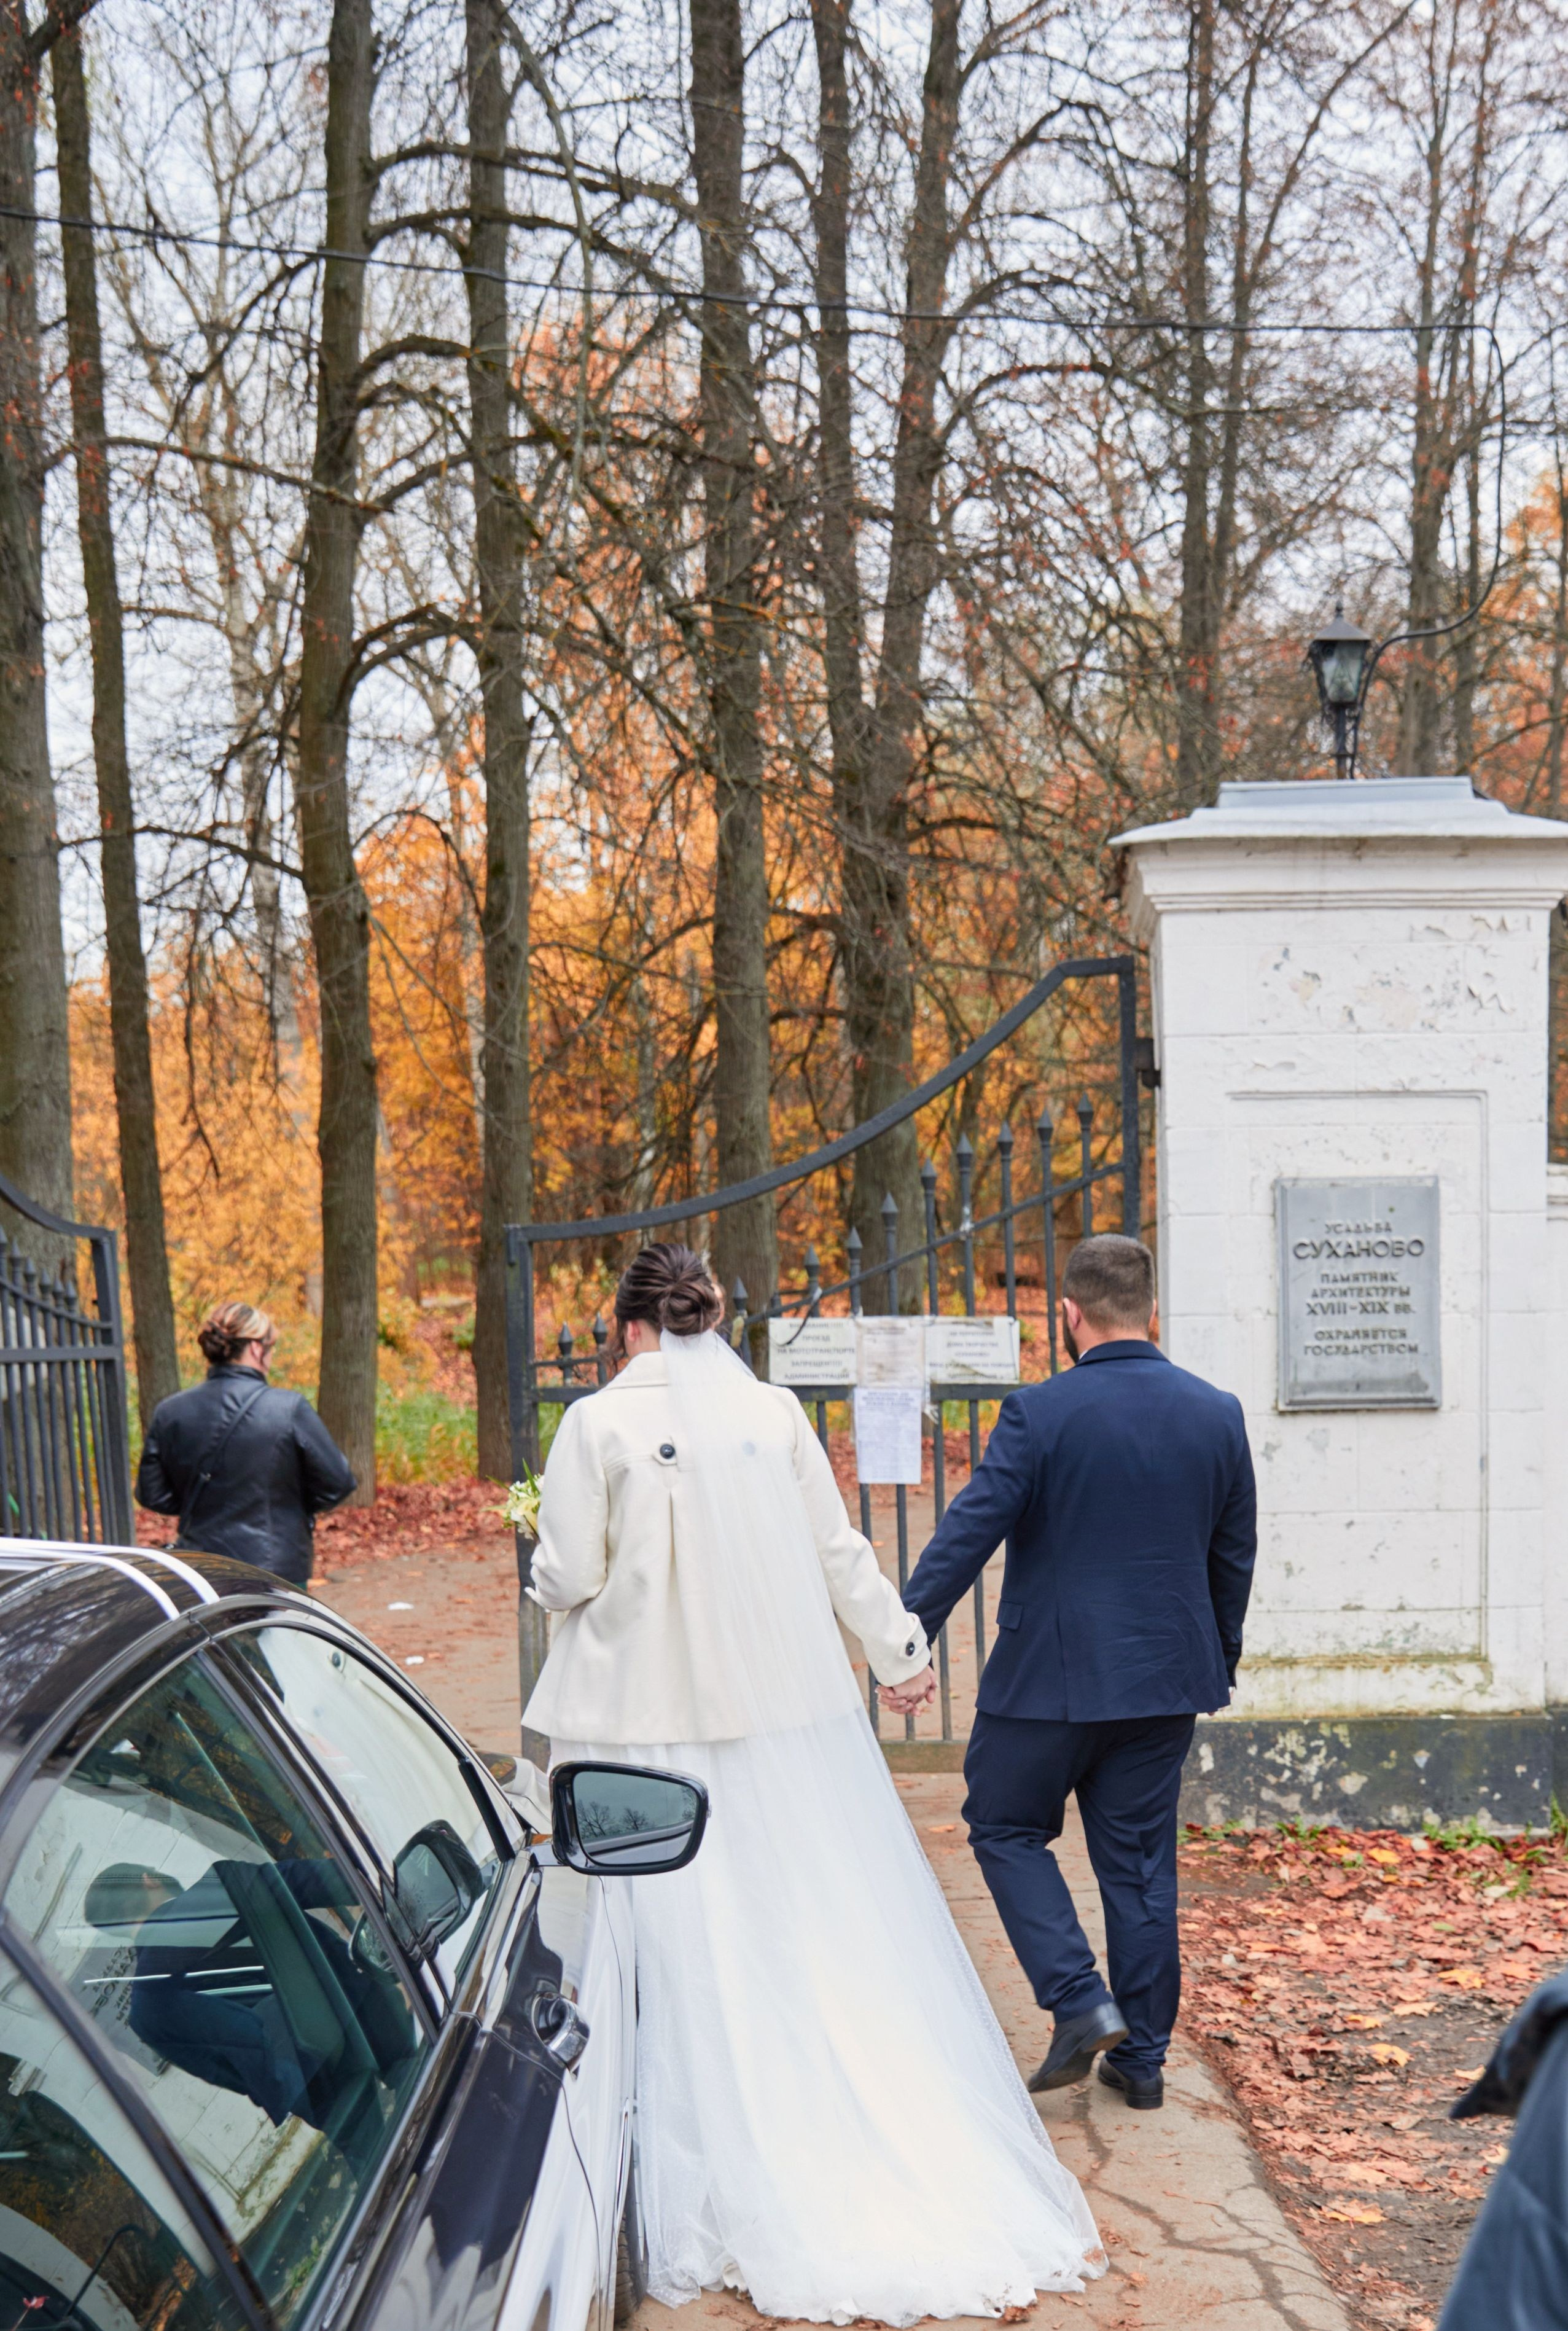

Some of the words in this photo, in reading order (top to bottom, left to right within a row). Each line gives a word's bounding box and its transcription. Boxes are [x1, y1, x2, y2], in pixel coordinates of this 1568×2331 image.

[1324, 1221, 1392, 1234] УСАДЬБА
[1293, 1238, 1425, 1259] СУХАНОВО
[1320, 1271, 1399, 1284] ПАМЯТНИК
[1311, 1286, 1411, 1299] АРХИТЕКТУРЫ
[1314, 1328, 1407, 1341] ОХРАНЯЕТСЯ
[1303, 1343, 1419, 1357] ГОСУДАРСТВОМ
